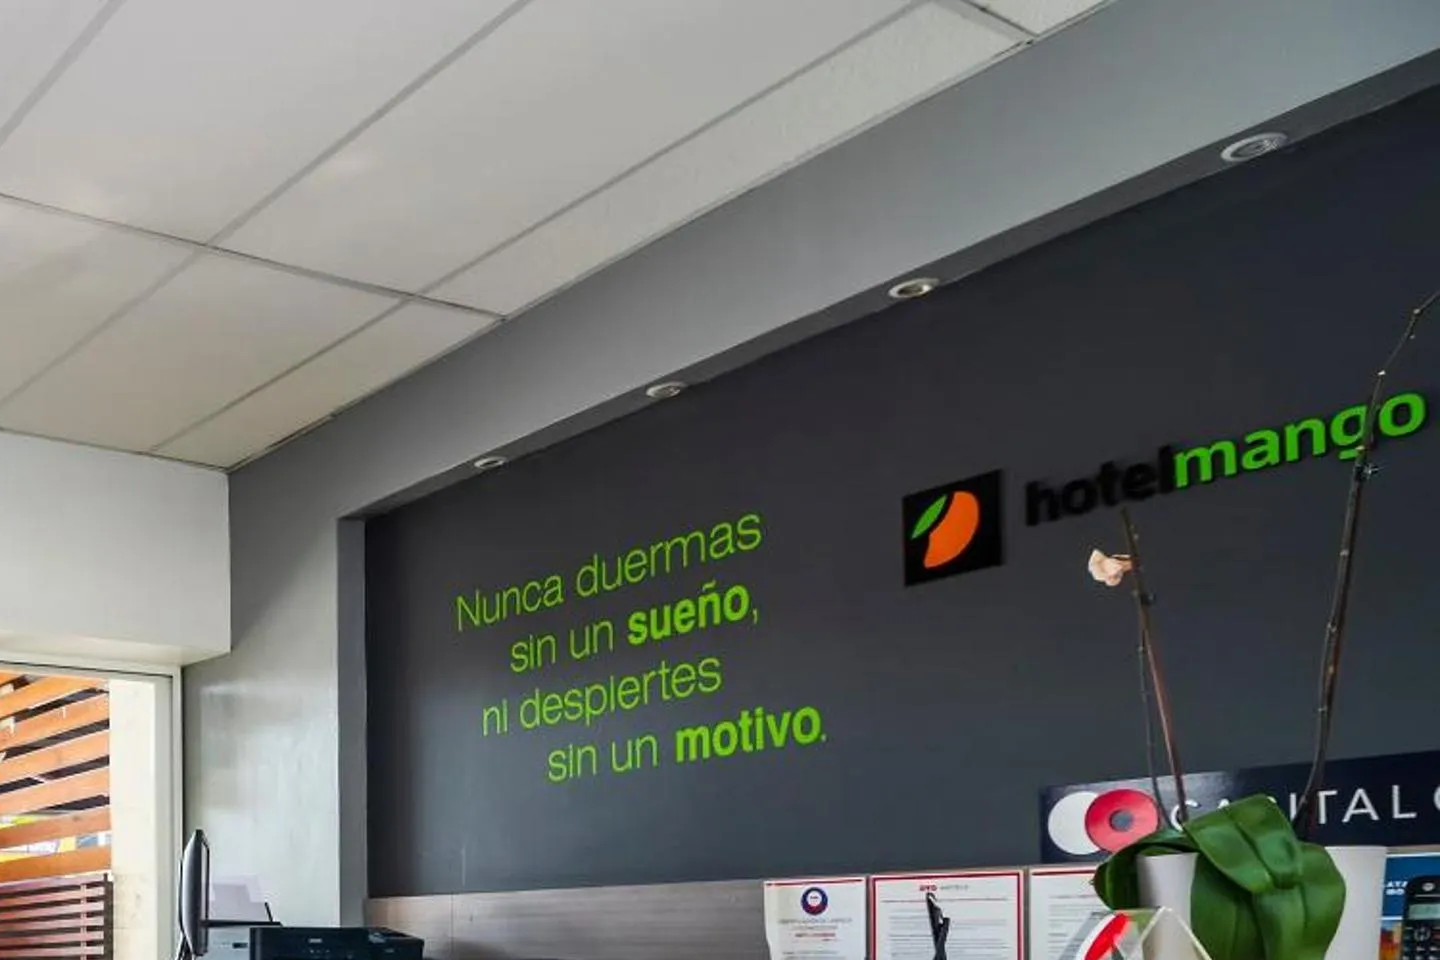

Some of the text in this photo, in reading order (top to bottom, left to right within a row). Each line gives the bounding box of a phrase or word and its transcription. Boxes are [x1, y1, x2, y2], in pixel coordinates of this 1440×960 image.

[455, 512, 764, 631] Nunca duermas
[509, 579, 760, 674] sin un sueño,
[482, 656, 724, 736] ni despiertes
[546, 704, 827, 783] sin un motivo.
